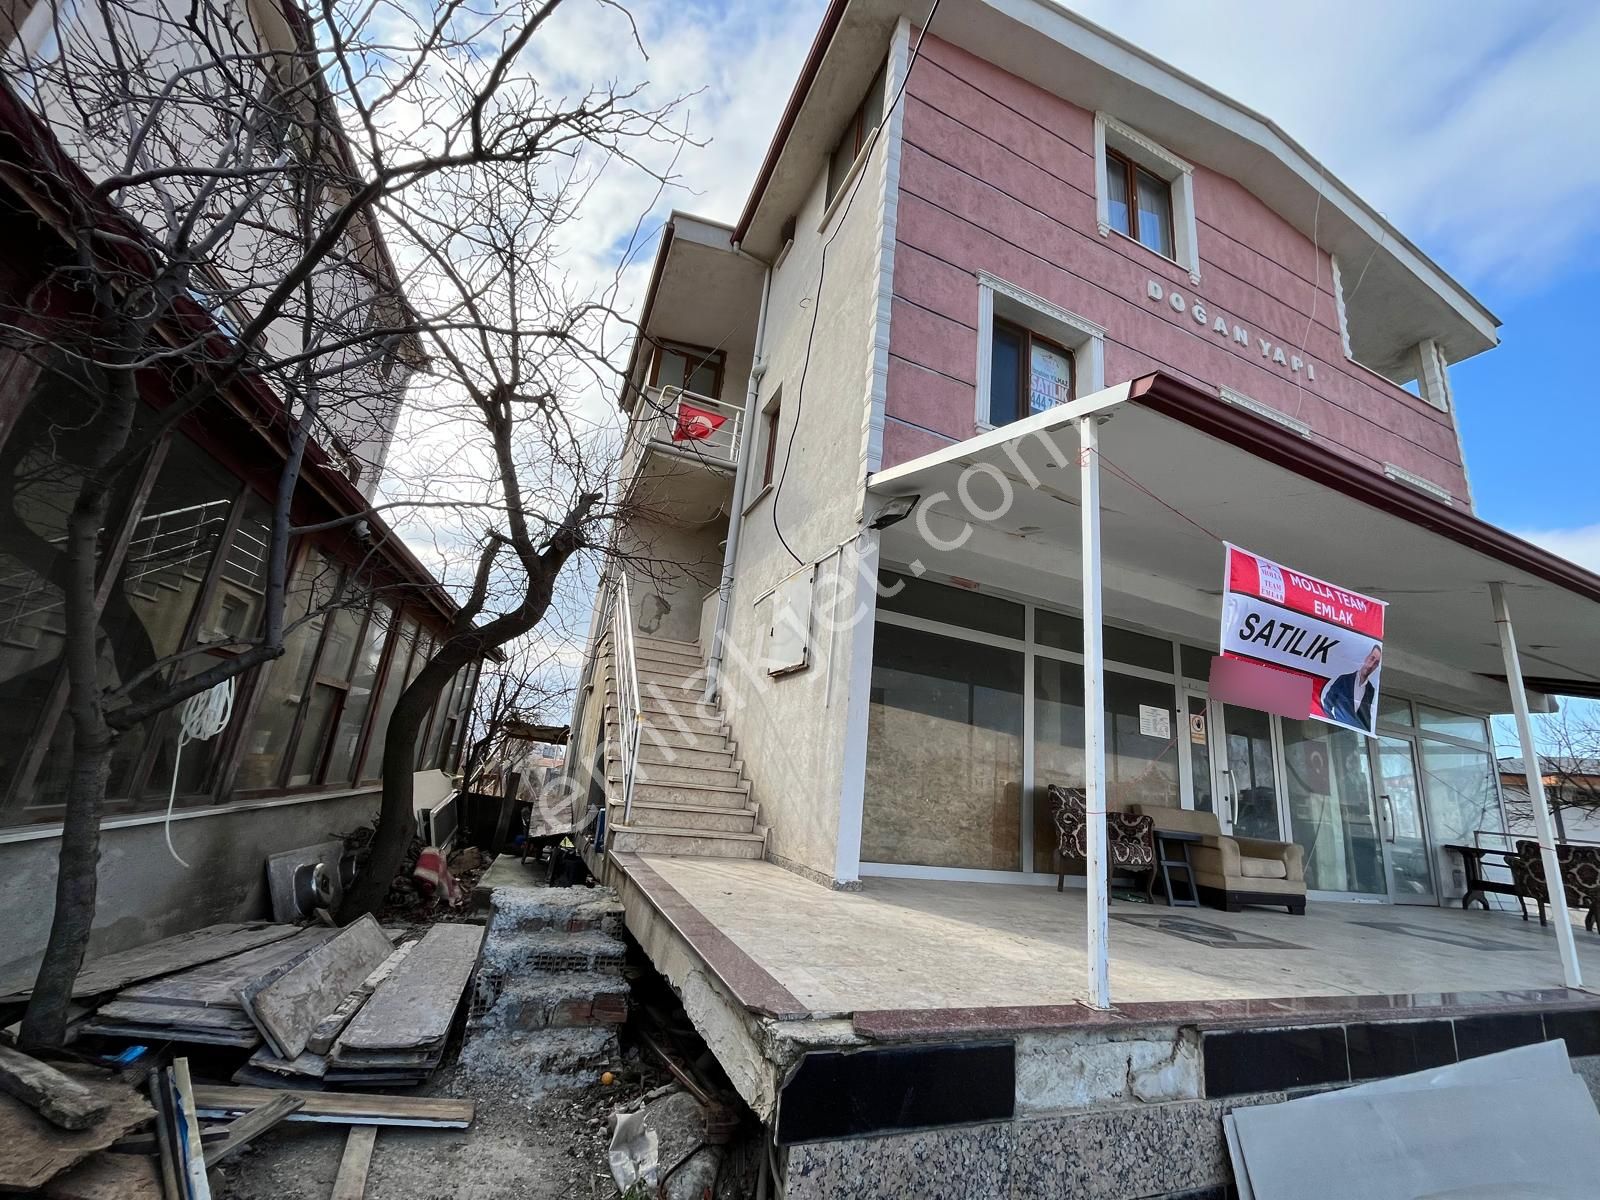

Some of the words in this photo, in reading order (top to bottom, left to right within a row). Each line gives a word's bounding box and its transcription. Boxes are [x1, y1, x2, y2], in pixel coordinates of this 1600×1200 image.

[1147, 280, 1249, 347] DOĞAN
[1258, 337, 1316, 382] YAPI
[1031, 375, 1069, 403] SATILIK
[1290, 573, 1335, 600] MOLLA
[1336, 592, 1368, 614] TEAM
[1313, 600, 1355, 627] EMLAK
[1239, 613, 1340, 664] SATILIK
